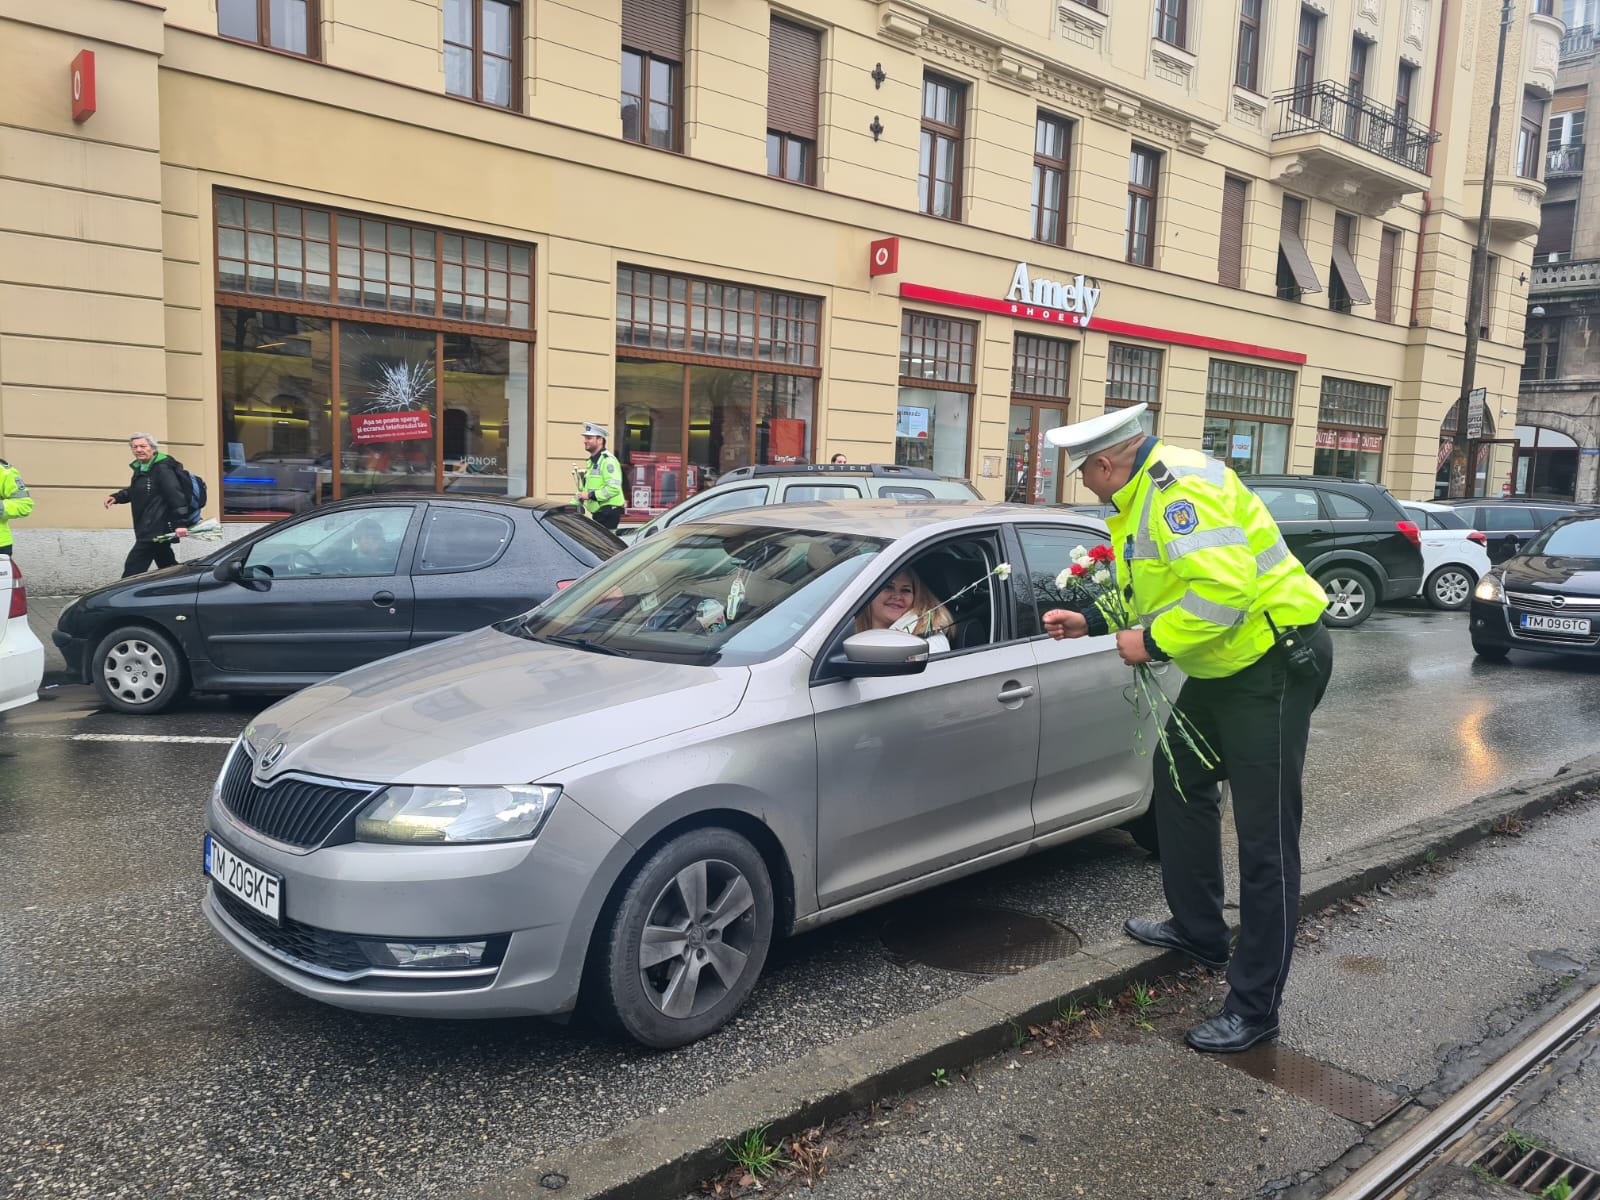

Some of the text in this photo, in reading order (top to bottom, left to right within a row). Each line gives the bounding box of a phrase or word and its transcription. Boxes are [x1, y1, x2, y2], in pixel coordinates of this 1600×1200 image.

[1005, 262, 1101, 328] Amely
[1010, 304, 1079, 324] SHOES
[460, 455, 497, 467] HONOR
[1528, 616, 1588, 631] TM 09GTC
[211, 842, 278, 909] TM 20GKF
